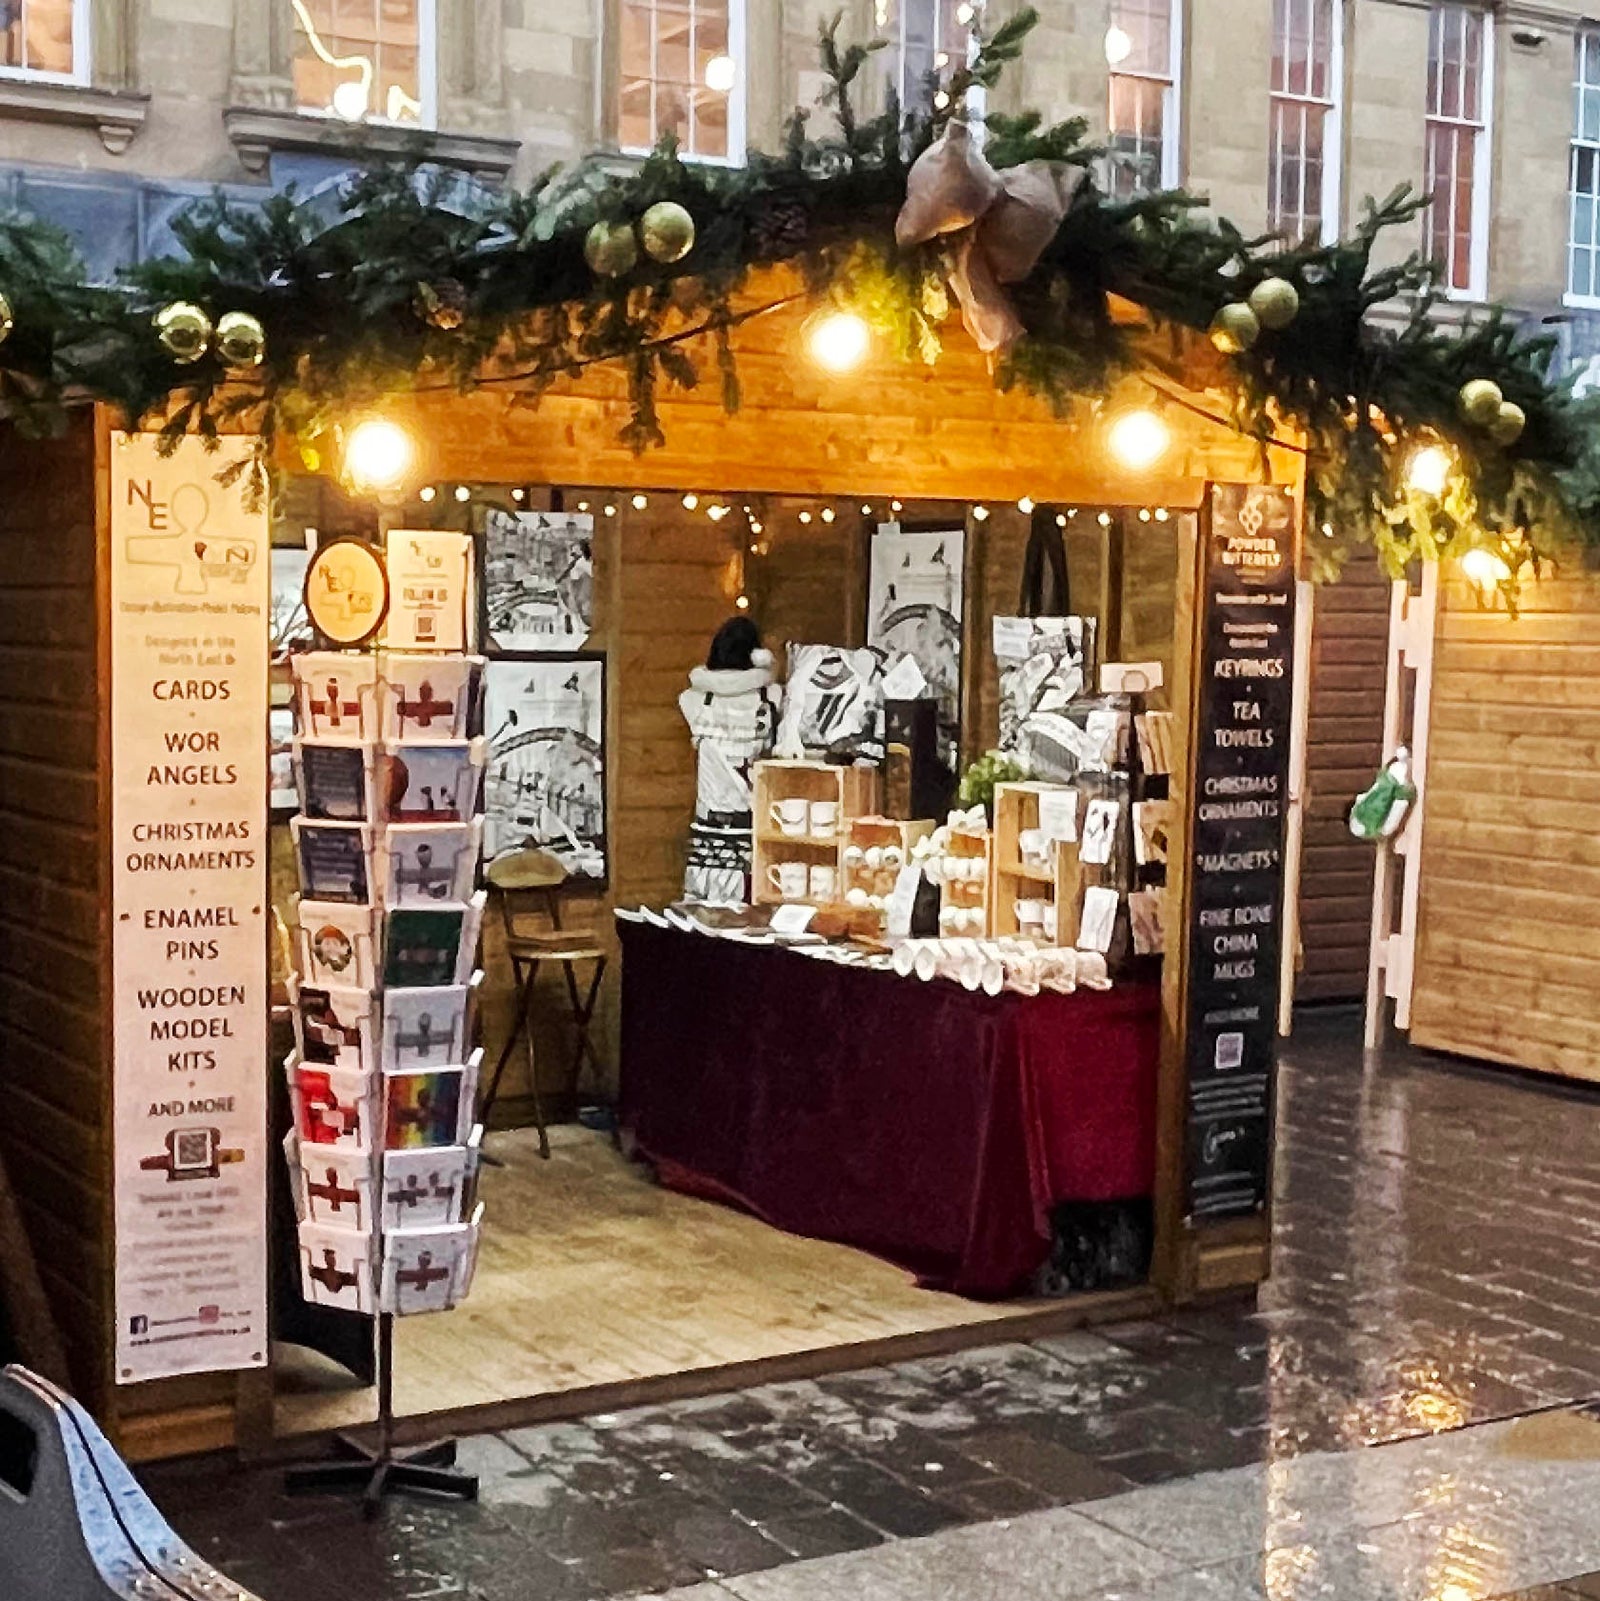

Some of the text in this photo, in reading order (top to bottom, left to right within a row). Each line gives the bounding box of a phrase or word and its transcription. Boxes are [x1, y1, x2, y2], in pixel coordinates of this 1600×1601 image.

[152, 679, 231, 700] CARDS
[1232, 701, 1261, 720] TEA
[164, 731, 220, 752] WOR
[1214, 729, 1274, 748] TOWELS
[147, 764, 238, 786] ANGELS
[132, 820, 250, 842] CHRISTMAS
[126, 850, 256, 872] ORNAMENTS
[144, 907, 239, 929] ENAMEL
[166, 939, 219, 961] PINS
[1213, 932, 1258, 955] CHINA
[1213, 960, 1255, 980] MUGS
[137, 985, 246, 1009] WOODEN
[150, 1017, 234, 1041] MODEL
[168, 1049, 216, 1072] KITS
[148, 1096, 236, 1118] AND MORE
